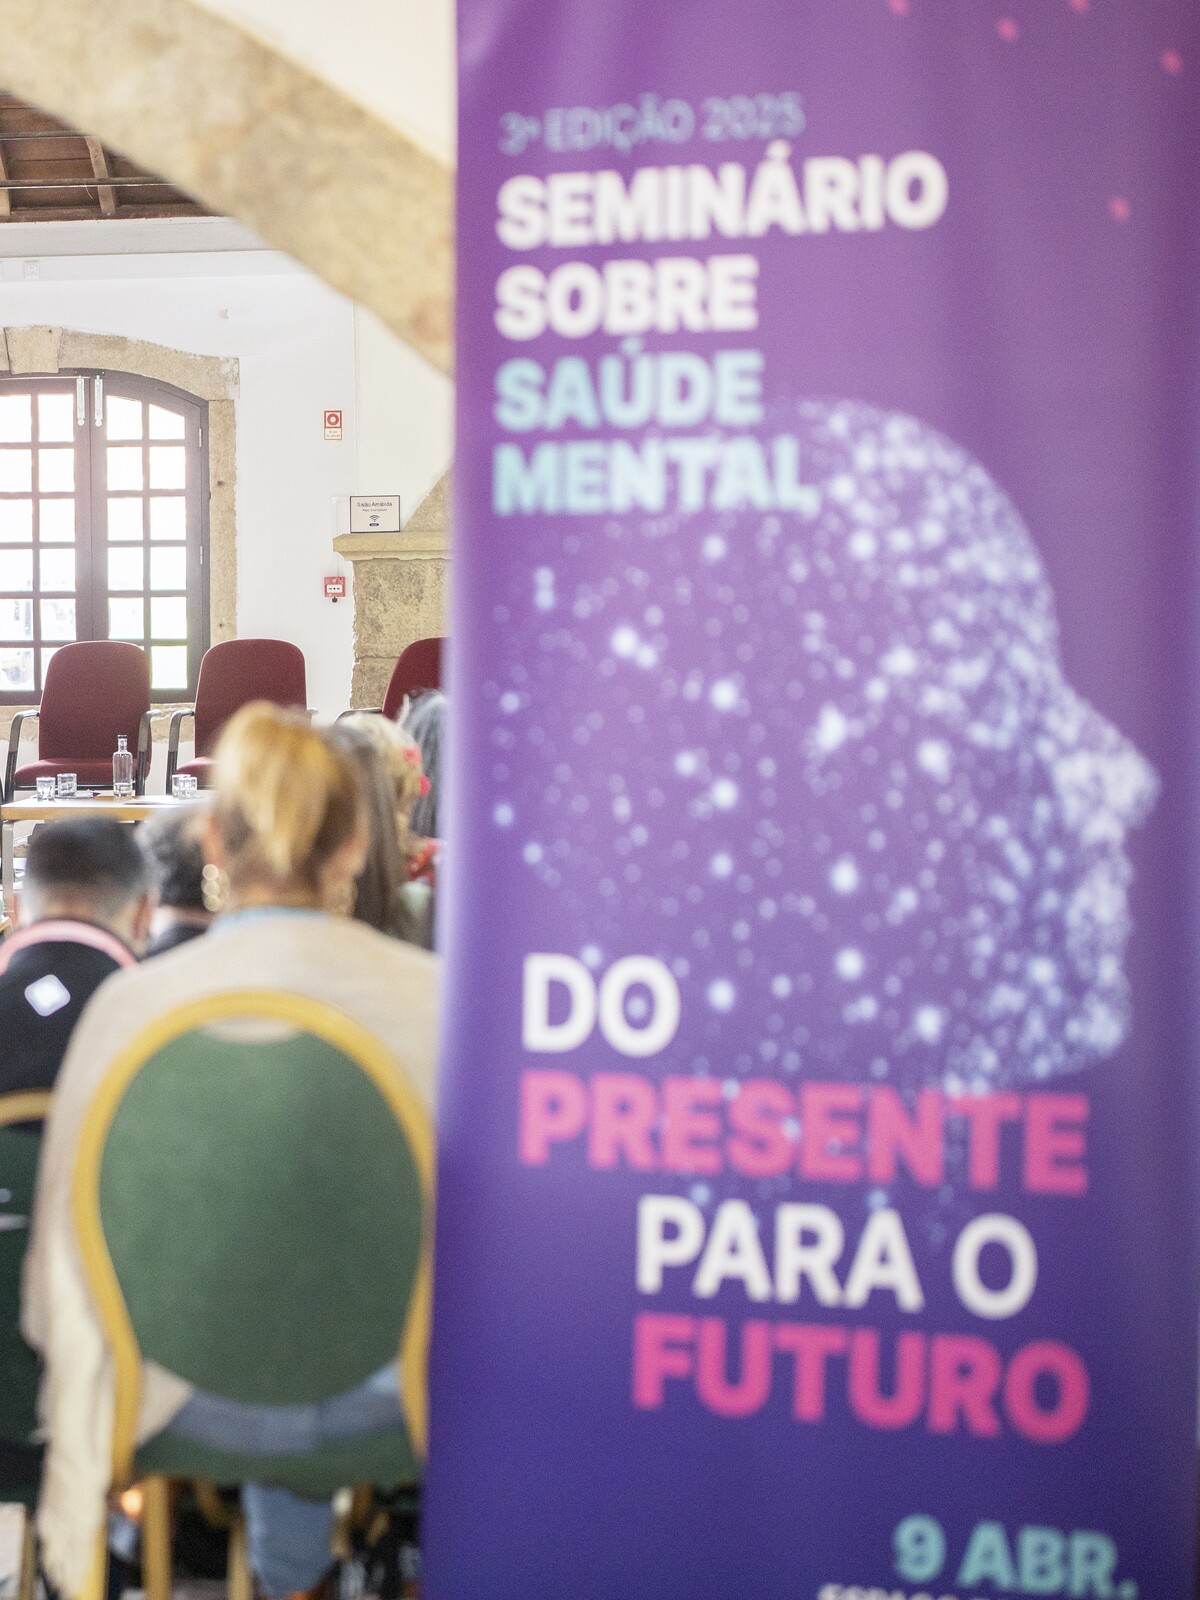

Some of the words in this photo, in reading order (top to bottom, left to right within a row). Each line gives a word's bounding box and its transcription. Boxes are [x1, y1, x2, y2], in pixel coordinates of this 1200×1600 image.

[543, 91, 696, 157] EDIÇÃO
[702, 90, 806, 142] 2025
[497, 139, 949, 250] SEMINÁRIO
[496, 254, 759, 340] SOBRE
[496, 334, 764, 430] SAÚDE
[494, 434, 820, 516] MENTAL
[521, 953, 681, 1057] DO
[519, 1070, 1090, 1194] PRESENTE
[636, 1195, 925, 1313] PARA
[951, 1213, 1038, 1320] O
[633, 1312, 1090, 1443] FUTURO
[894, 1513, 947, 1584] 9
[955, 1519, 1139, 1600] ABR.
